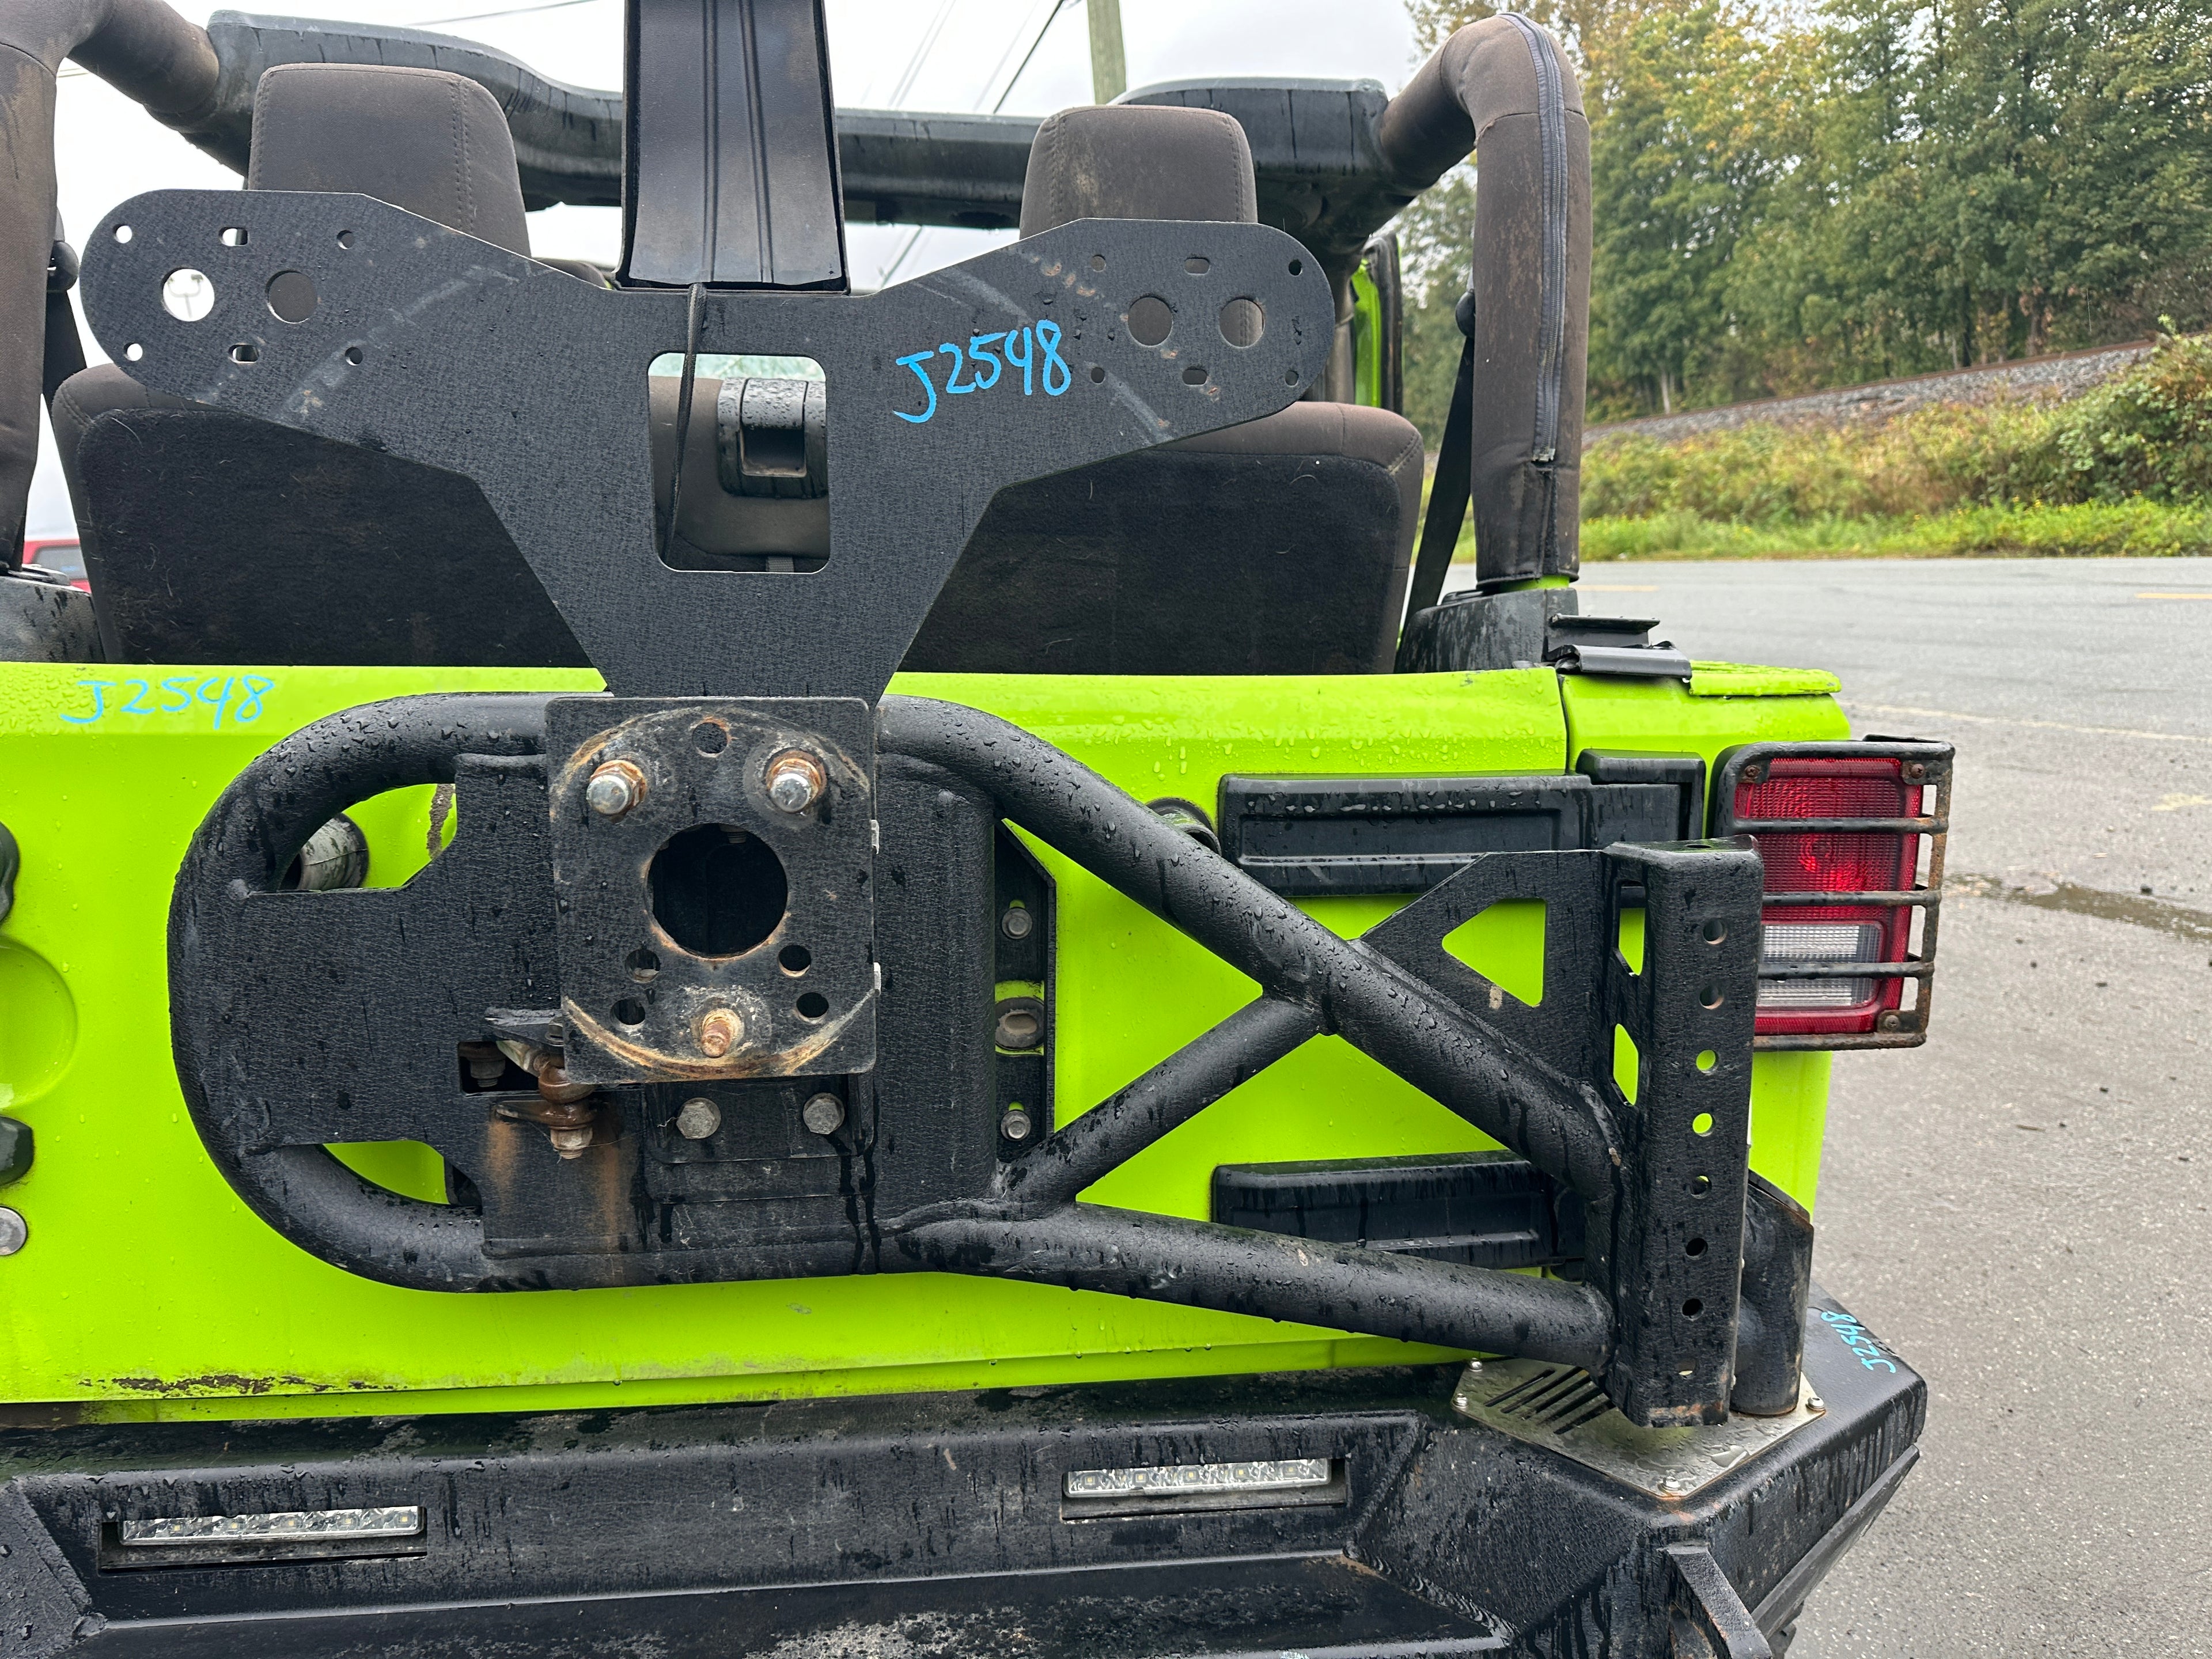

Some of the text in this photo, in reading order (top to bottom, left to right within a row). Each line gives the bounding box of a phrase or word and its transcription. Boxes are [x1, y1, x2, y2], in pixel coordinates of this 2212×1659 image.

[892, 319, 1072, 423] J2548
[59, 675, 275, 729] J2548
[1821, 1310, 1896, 1373] J2548
